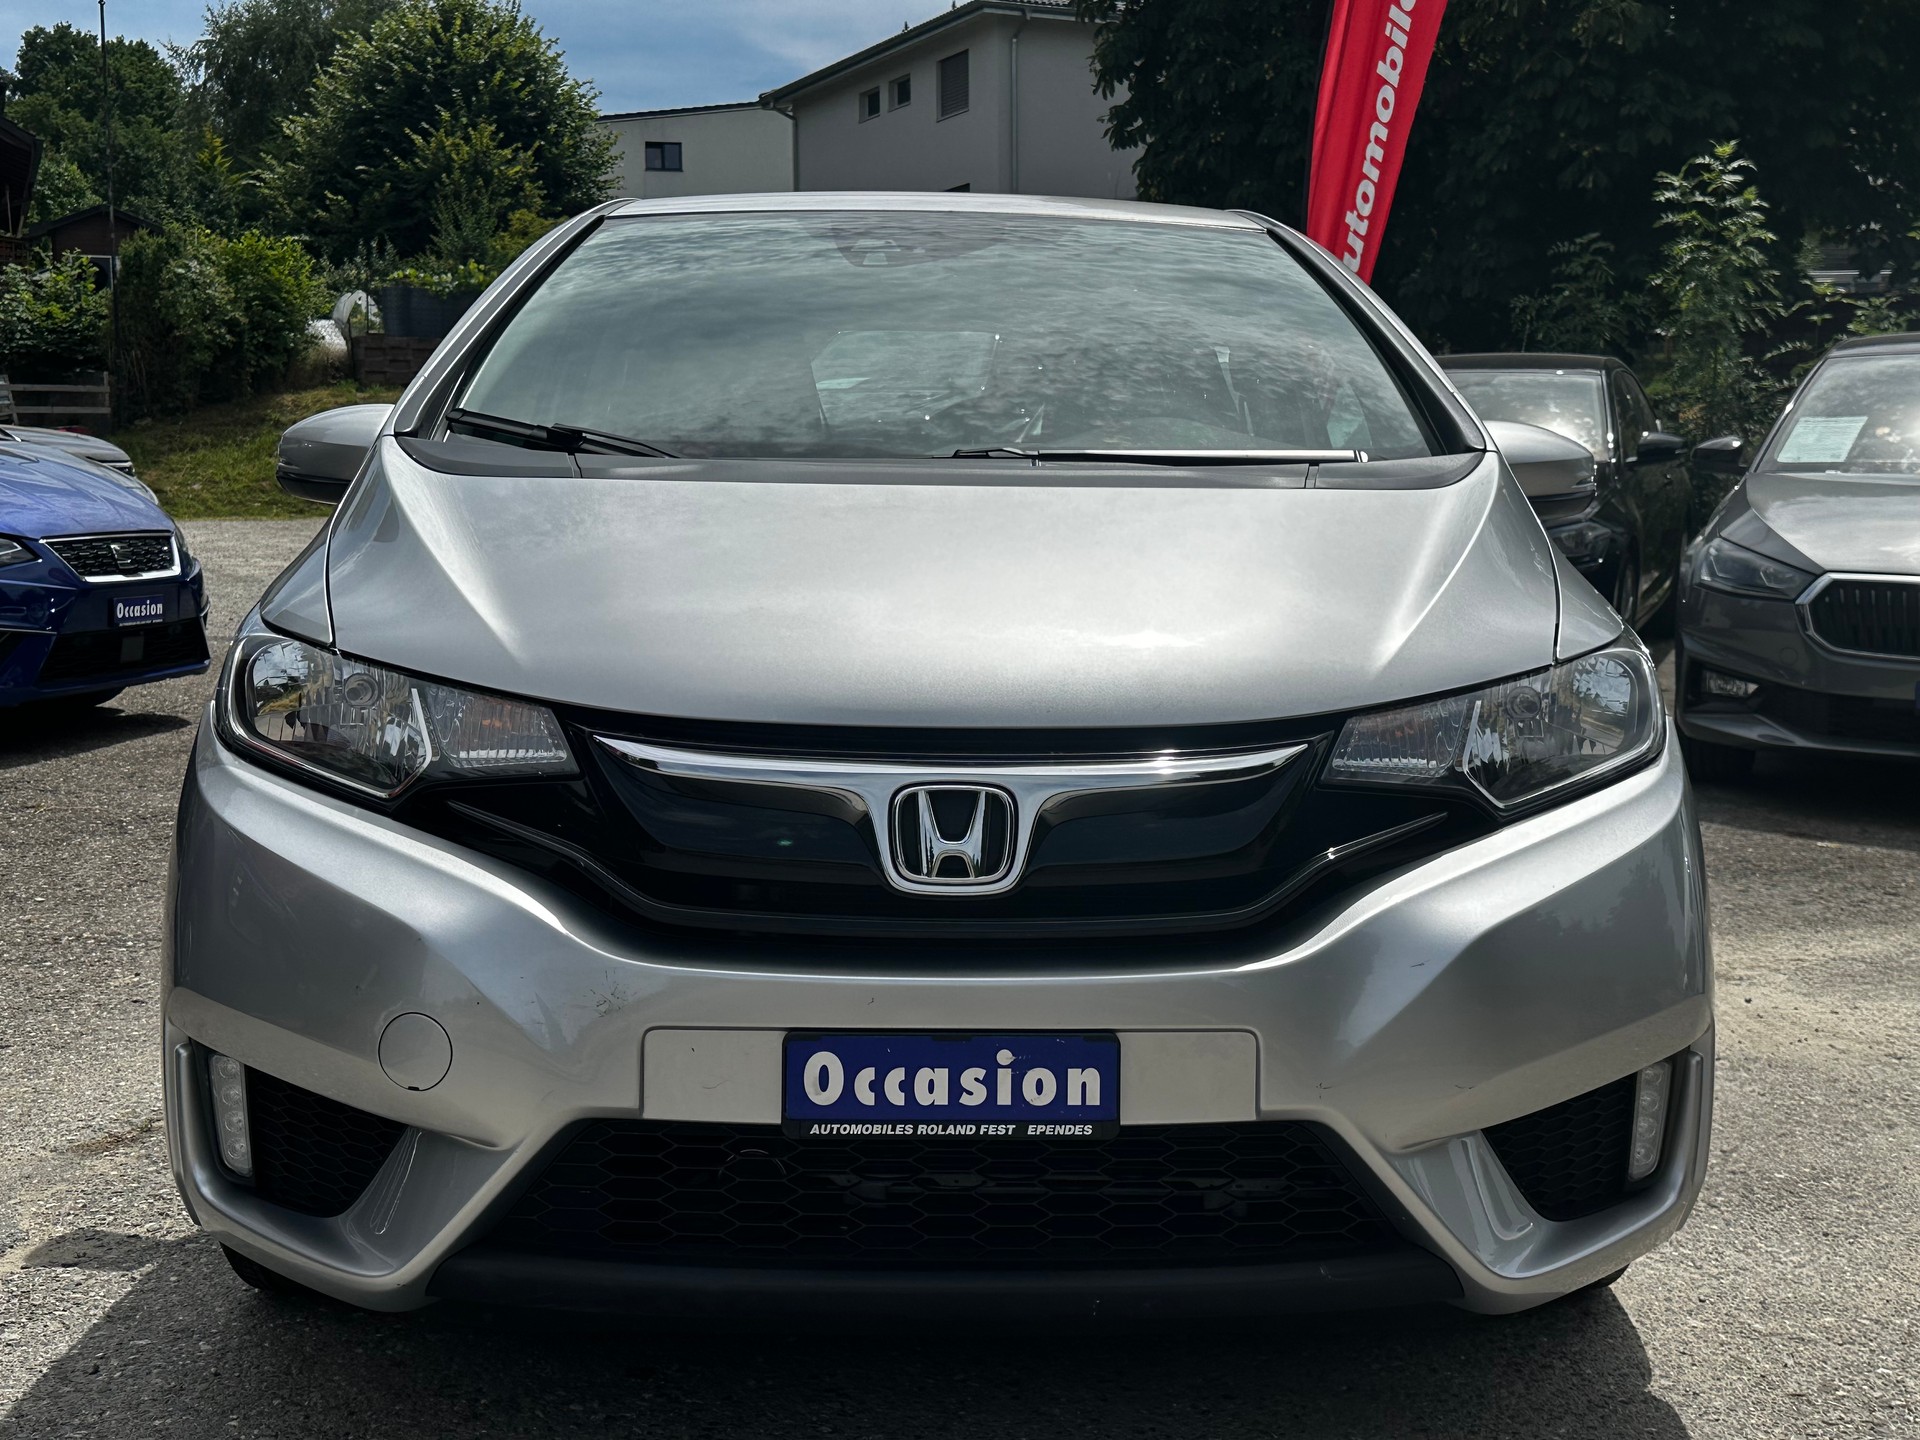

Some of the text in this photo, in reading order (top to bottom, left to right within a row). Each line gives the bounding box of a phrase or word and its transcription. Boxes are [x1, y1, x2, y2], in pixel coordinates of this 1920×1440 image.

[116, 599, 163, 618] Occasion
[803, 1049, 1101, 1107] Occasion
[810, 1124, 1093, 1135] AUTOMOBILES ROLAND FEST EPENDES
